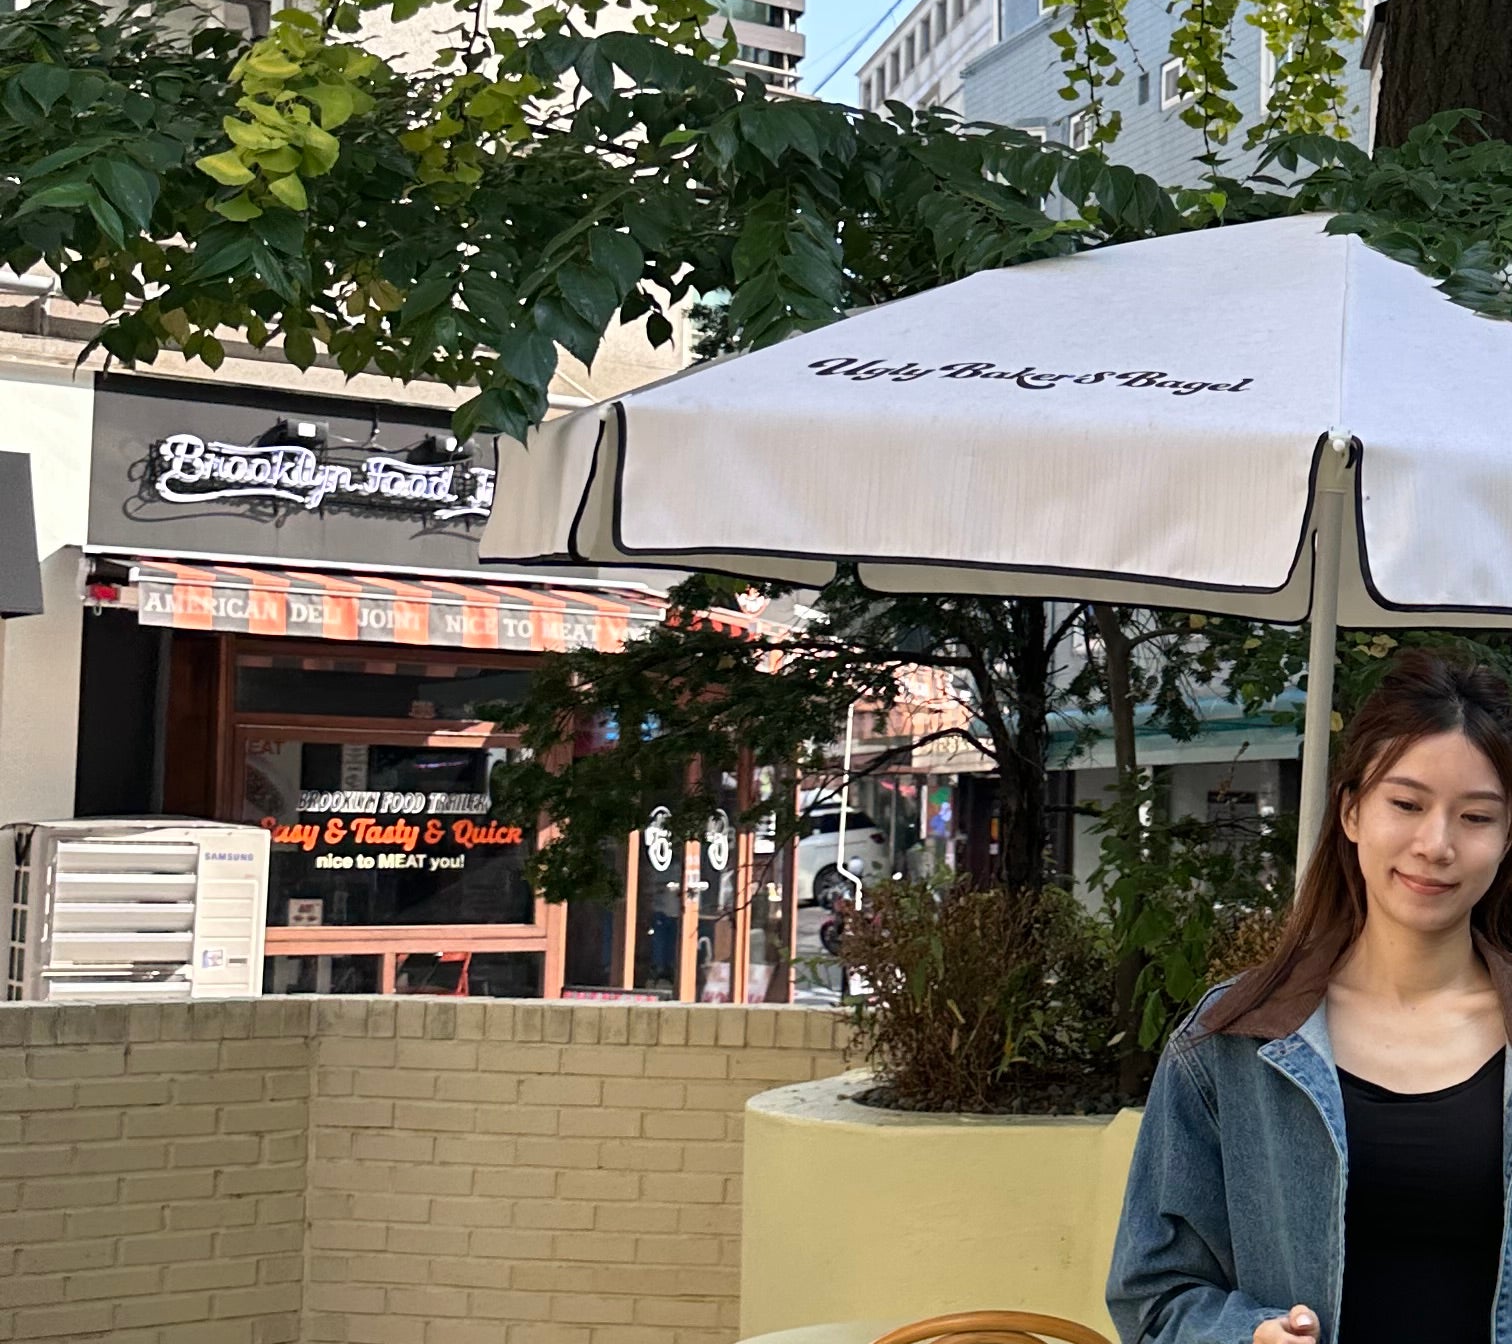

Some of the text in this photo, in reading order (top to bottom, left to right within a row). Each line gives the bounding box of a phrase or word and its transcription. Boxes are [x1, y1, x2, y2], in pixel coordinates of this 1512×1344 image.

[808, 357, 936, 382] Ugly
[938, 362, 1075, 390] Baker
[1115, 370, 1254, 396] Bagel
[156, 434, 362, 510] Brooklyn
[362, 457, 459, 502] Food
[144, 592, 279, 621] AMERICAN
[290, 603, 342, 625] DELI
[358, 607, 423, 631] JOINT
[446, 613, 498, 636] NICE
[503, 618, 534, 638] TO
[541, 620, 597, 642] MEAT
[380, 791, 426, 814] FOOD
[324, 817, 347, 845] &
[350, 817, 420, 851] Tasty
[423, 819, 445, 845] &
[451, 818, 523, 849] Quick
[204, 852, 254, 862] SAMSUNG
[316, 853, 465, 871] nice to MEAT you!
